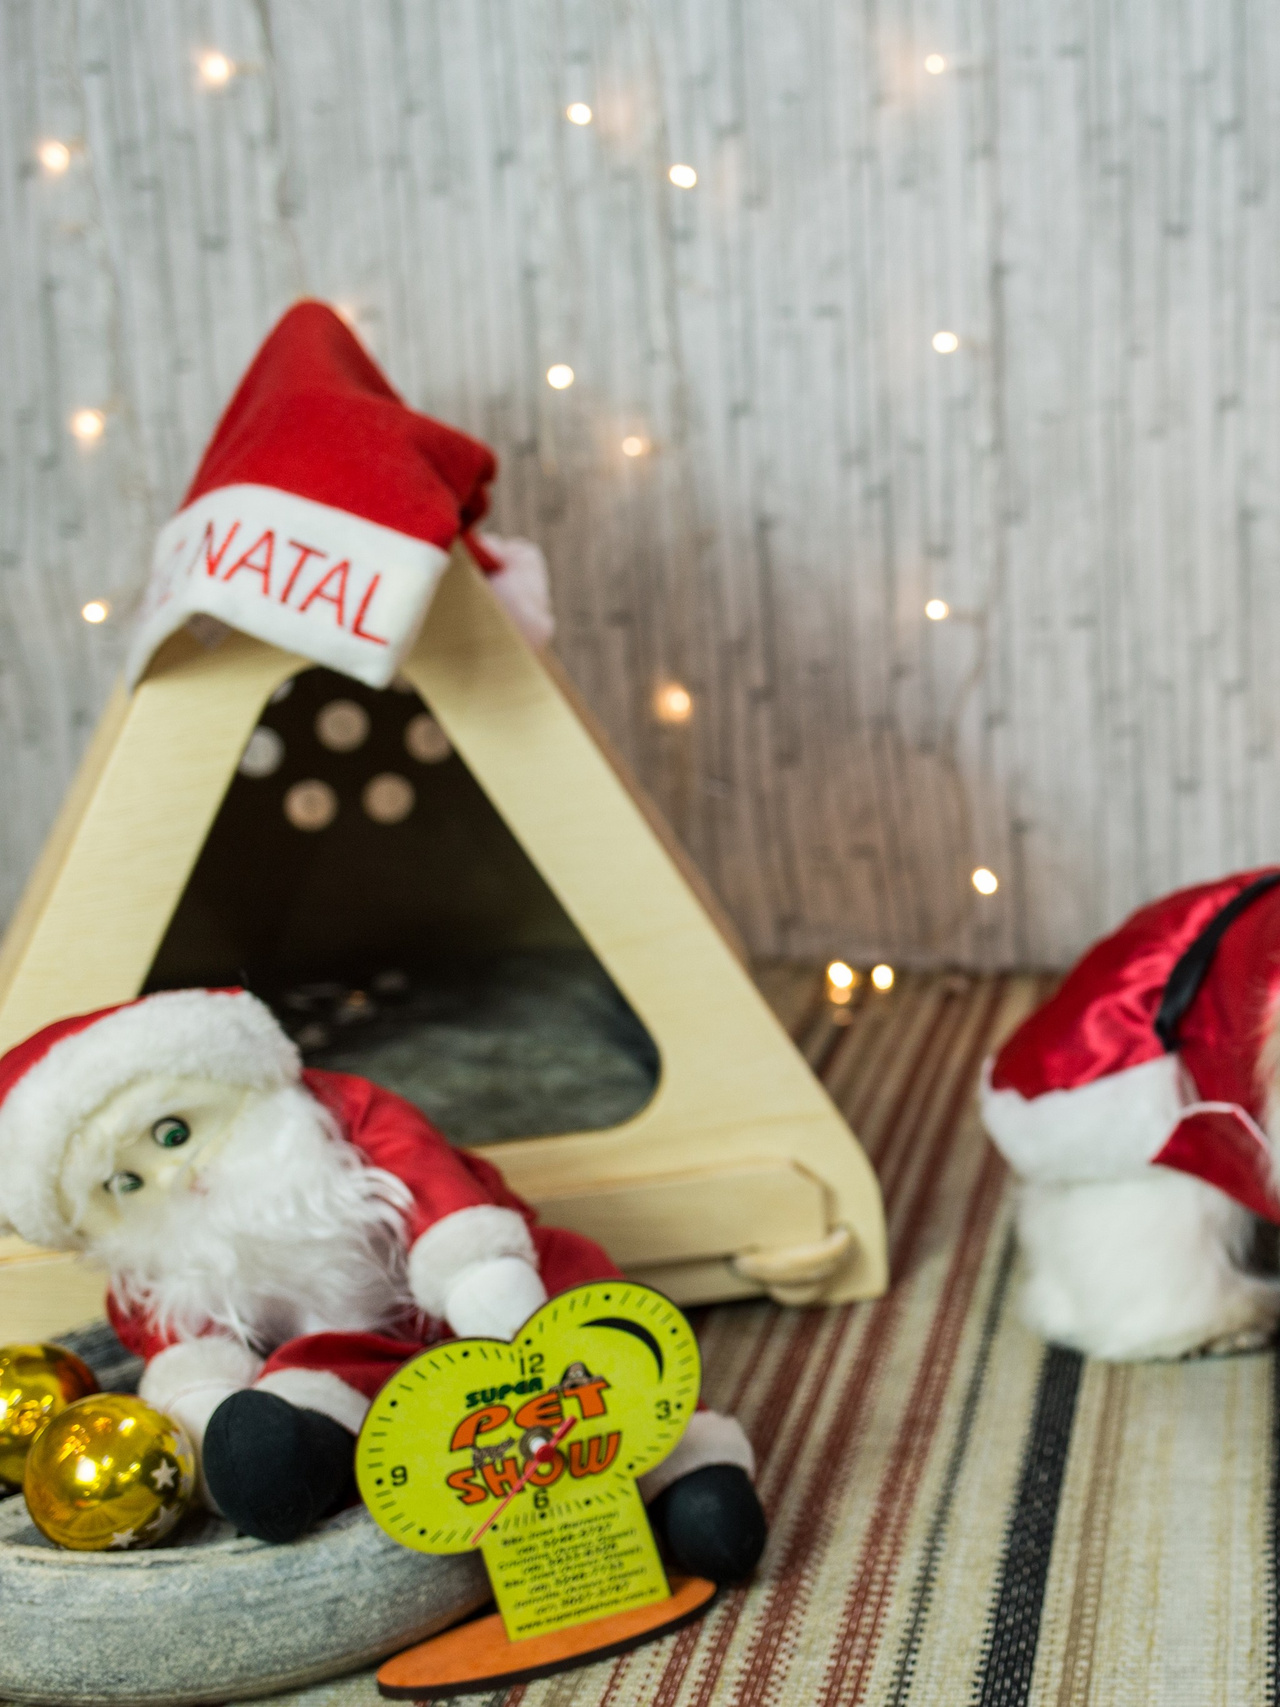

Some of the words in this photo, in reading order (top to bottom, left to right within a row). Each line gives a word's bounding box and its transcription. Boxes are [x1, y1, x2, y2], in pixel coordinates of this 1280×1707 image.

[187, 520, 389, 646] NATAL
[519, 1352, 546, 1376] 12
[465, 1376, 545, 1409] SUPER
[449, 1379, 612, 1452] PET
[655, 1399, 672, 1421] 3
[390, 1464, 408, 1486] 9
[446, 1430, 622, 1505] SHOW
[532, 1487, 550, 1510] 6
